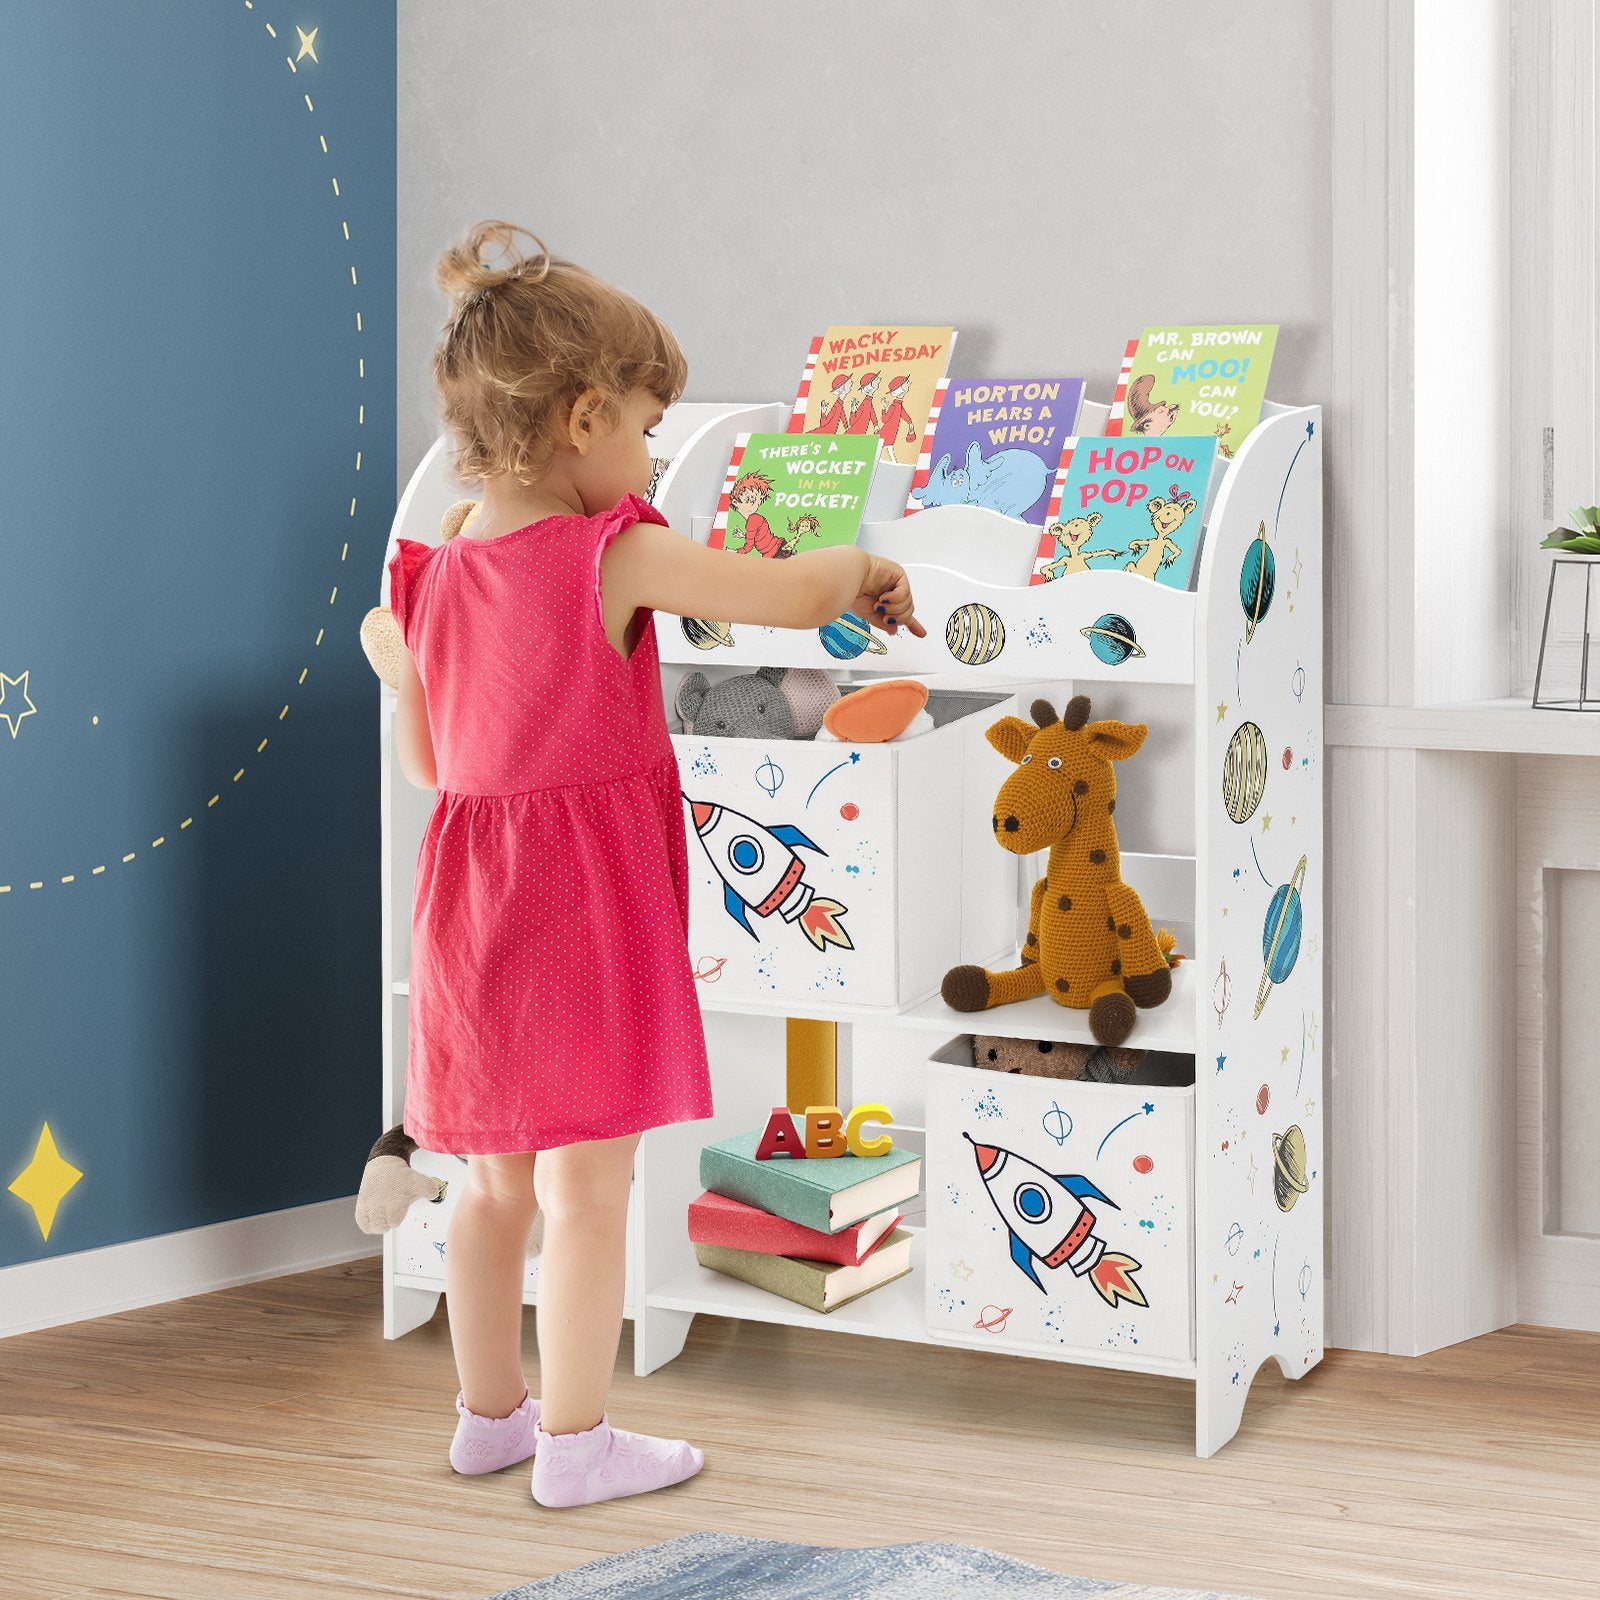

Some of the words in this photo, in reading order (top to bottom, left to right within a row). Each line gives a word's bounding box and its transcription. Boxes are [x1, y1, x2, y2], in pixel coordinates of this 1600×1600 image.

[829, 330, 899, 354] WACKY
[1148, 332, 1183, 349] MR.
[1190, 330, 1263, 347] BROWN
[822, 344, 942, 374] WEDNESDAY
[1156, 348, 1194, 363] CAN
[1171, 358, 1250, 385] MOO!
[954, 383, 1061, 408] HORTON
[1199, 385, 1236, 398] CAN
[967, 406, 1033, 425] HEARS
[1038, 406, 1052, 420] A
[1189, 400, 1239, 422] YOU?
[988, 425, 1055, 446] WHO!
[759, 442, 820, 460] THERE'S
[828, 442, 838, 454] A
[1088, 446, 1162, 475] HOP
[1164, 453, 1195, 472] ON
[786, 460, 866, 476] WOCKET
[797, 478, 814, 490] IN
[818, 479, 840, 491] MY
[1079, 479, 1149, 509] POP
[774, 492, 859, 510] POCKET!
[755, 1103, 895, 1160] ABC
